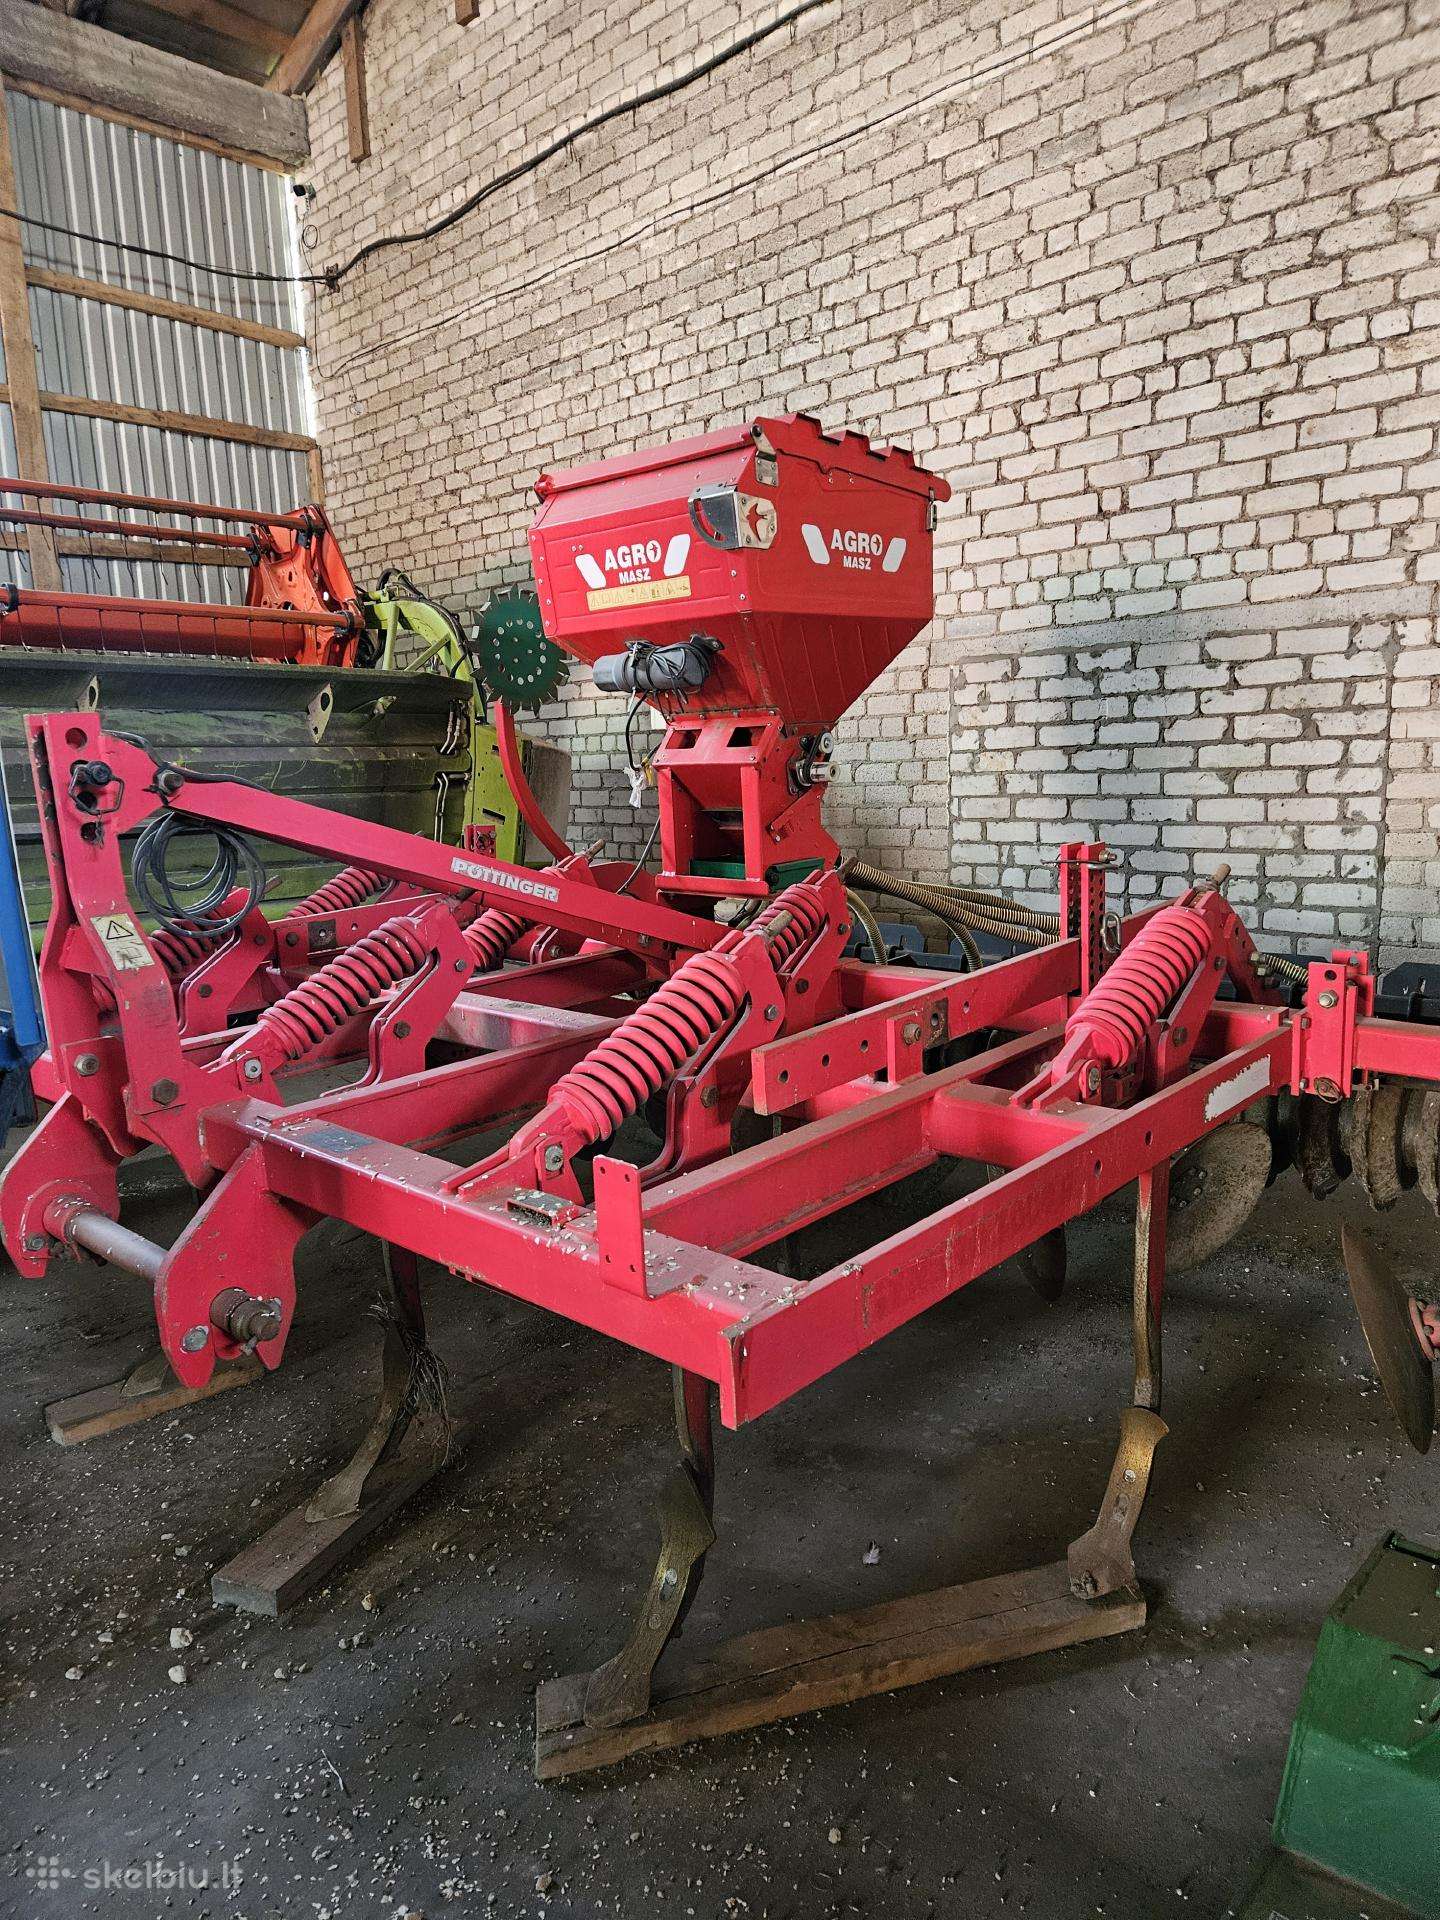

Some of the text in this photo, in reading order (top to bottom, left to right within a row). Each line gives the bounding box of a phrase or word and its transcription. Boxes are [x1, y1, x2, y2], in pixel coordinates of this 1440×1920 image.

[831, 529, 883, 556] AGRO
[605, 540, 661, 571] AGRO
[843, 556, 871, 570] MASZ
[619, 568, 651, 585] MASZ
